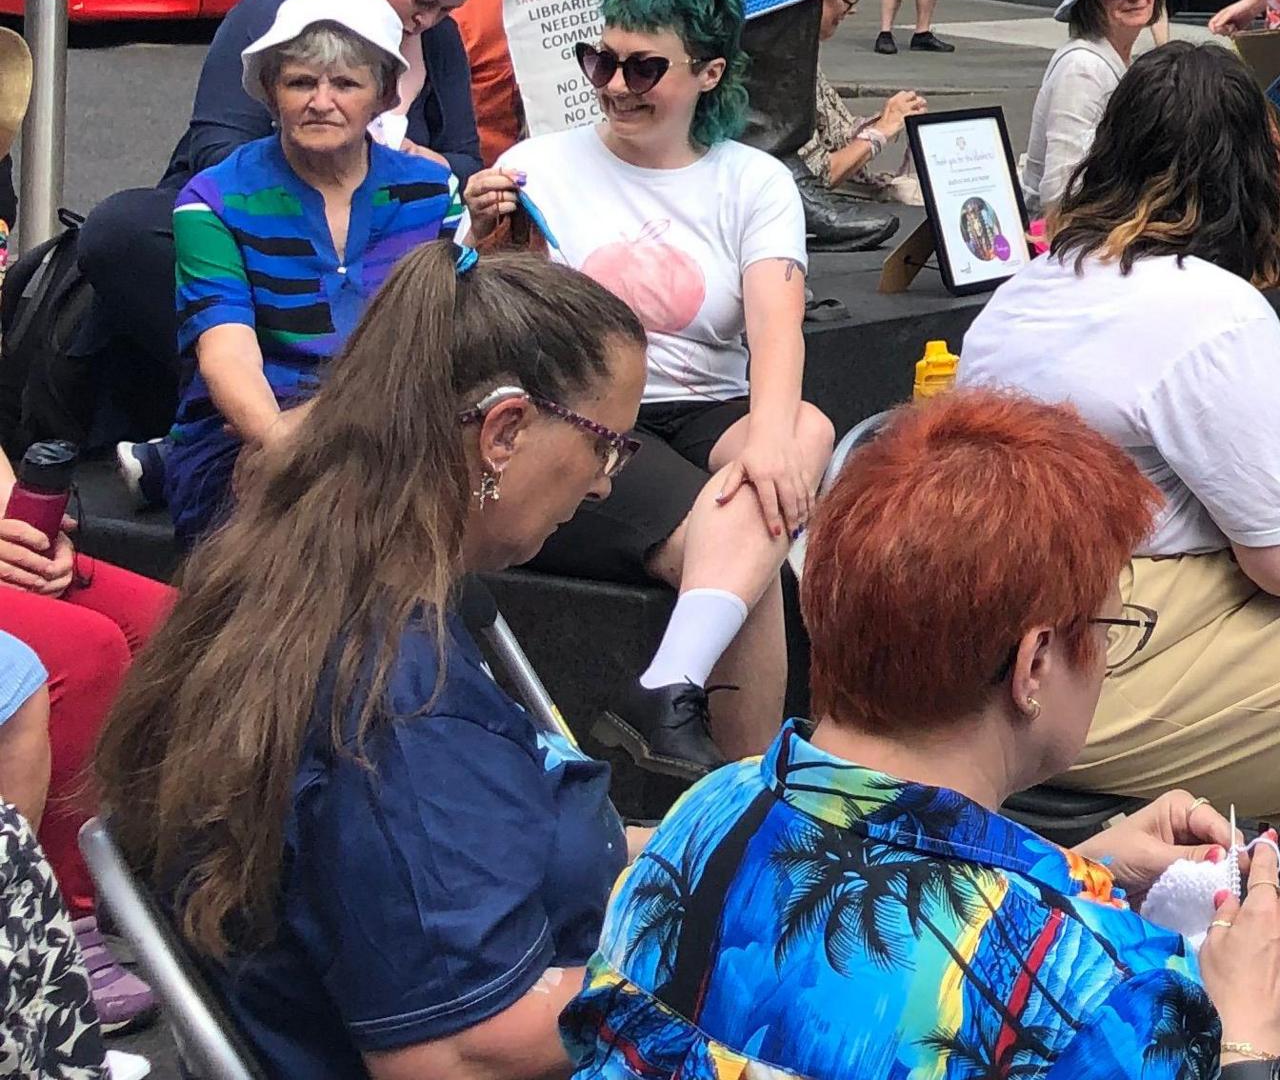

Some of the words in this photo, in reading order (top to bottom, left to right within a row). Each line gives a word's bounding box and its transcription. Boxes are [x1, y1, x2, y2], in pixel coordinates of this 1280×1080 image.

[541, 10, 600, 35] NEEDED
[542, 25, 604, 50] COMMU
[557, 78, 578, 96] NO
[564, 88, 599, 109] CLOS
[564, 108, 586, 125] NO
